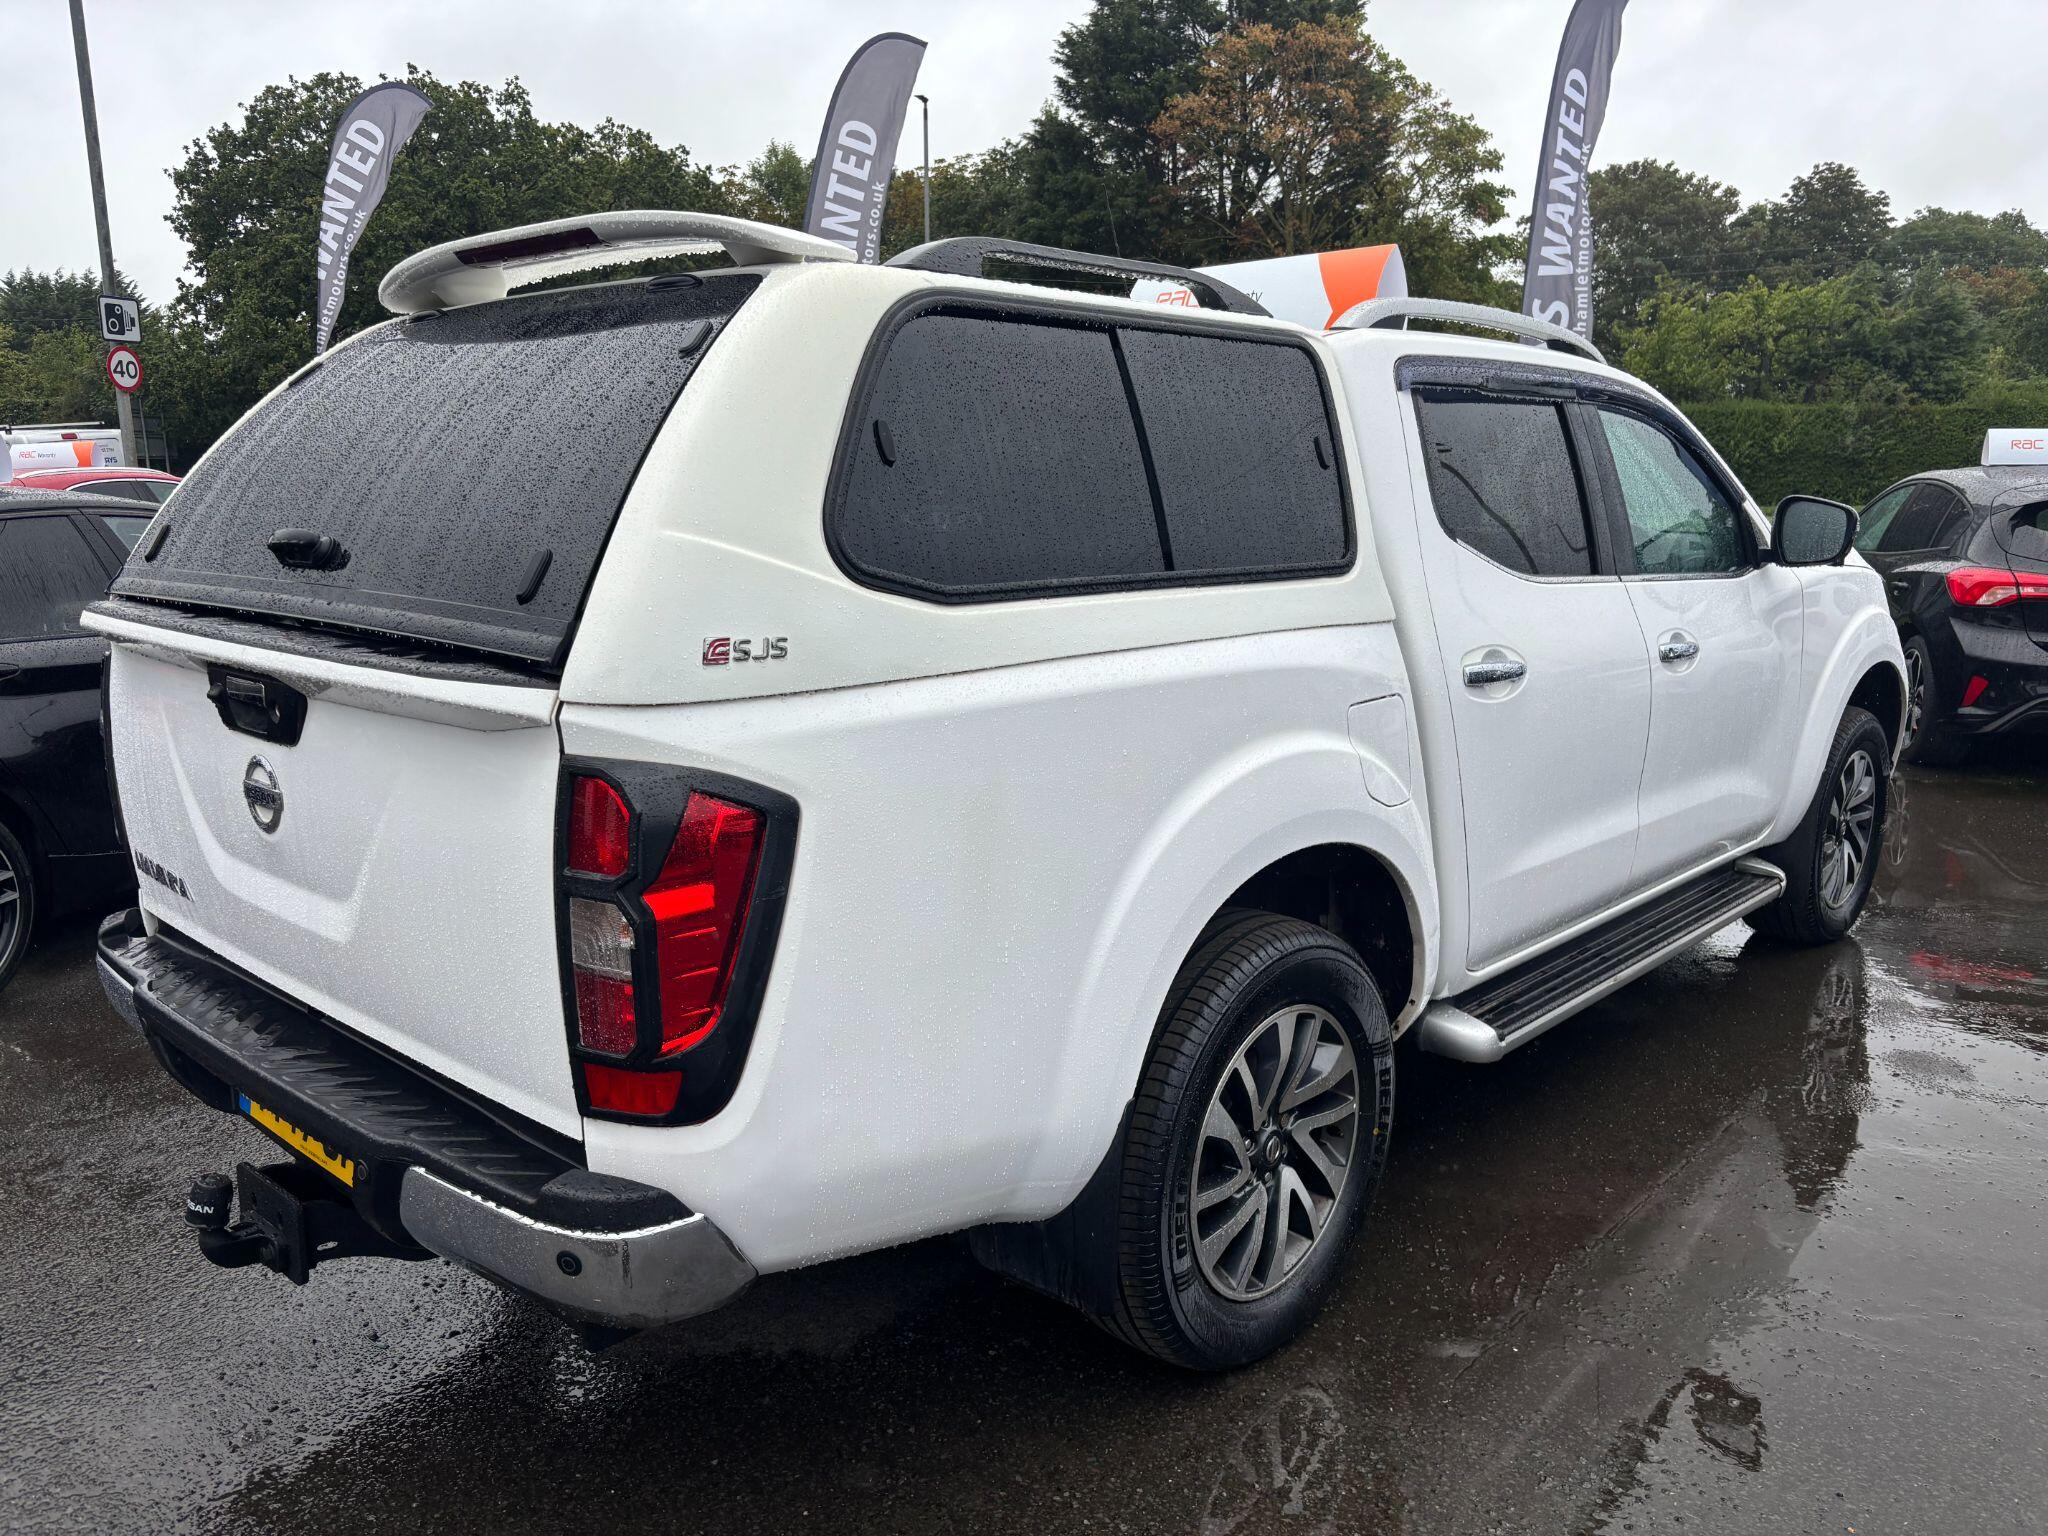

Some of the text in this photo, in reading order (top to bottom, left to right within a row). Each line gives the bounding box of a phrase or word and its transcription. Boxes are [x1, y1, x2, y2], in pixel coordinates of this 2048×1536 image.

[1537, 67, 1588, 276] WANTED
[113, 359, 138, 379] 40
[733, 637, 788, 662] SJS
[187, 1199, 215, 1214] SAN
